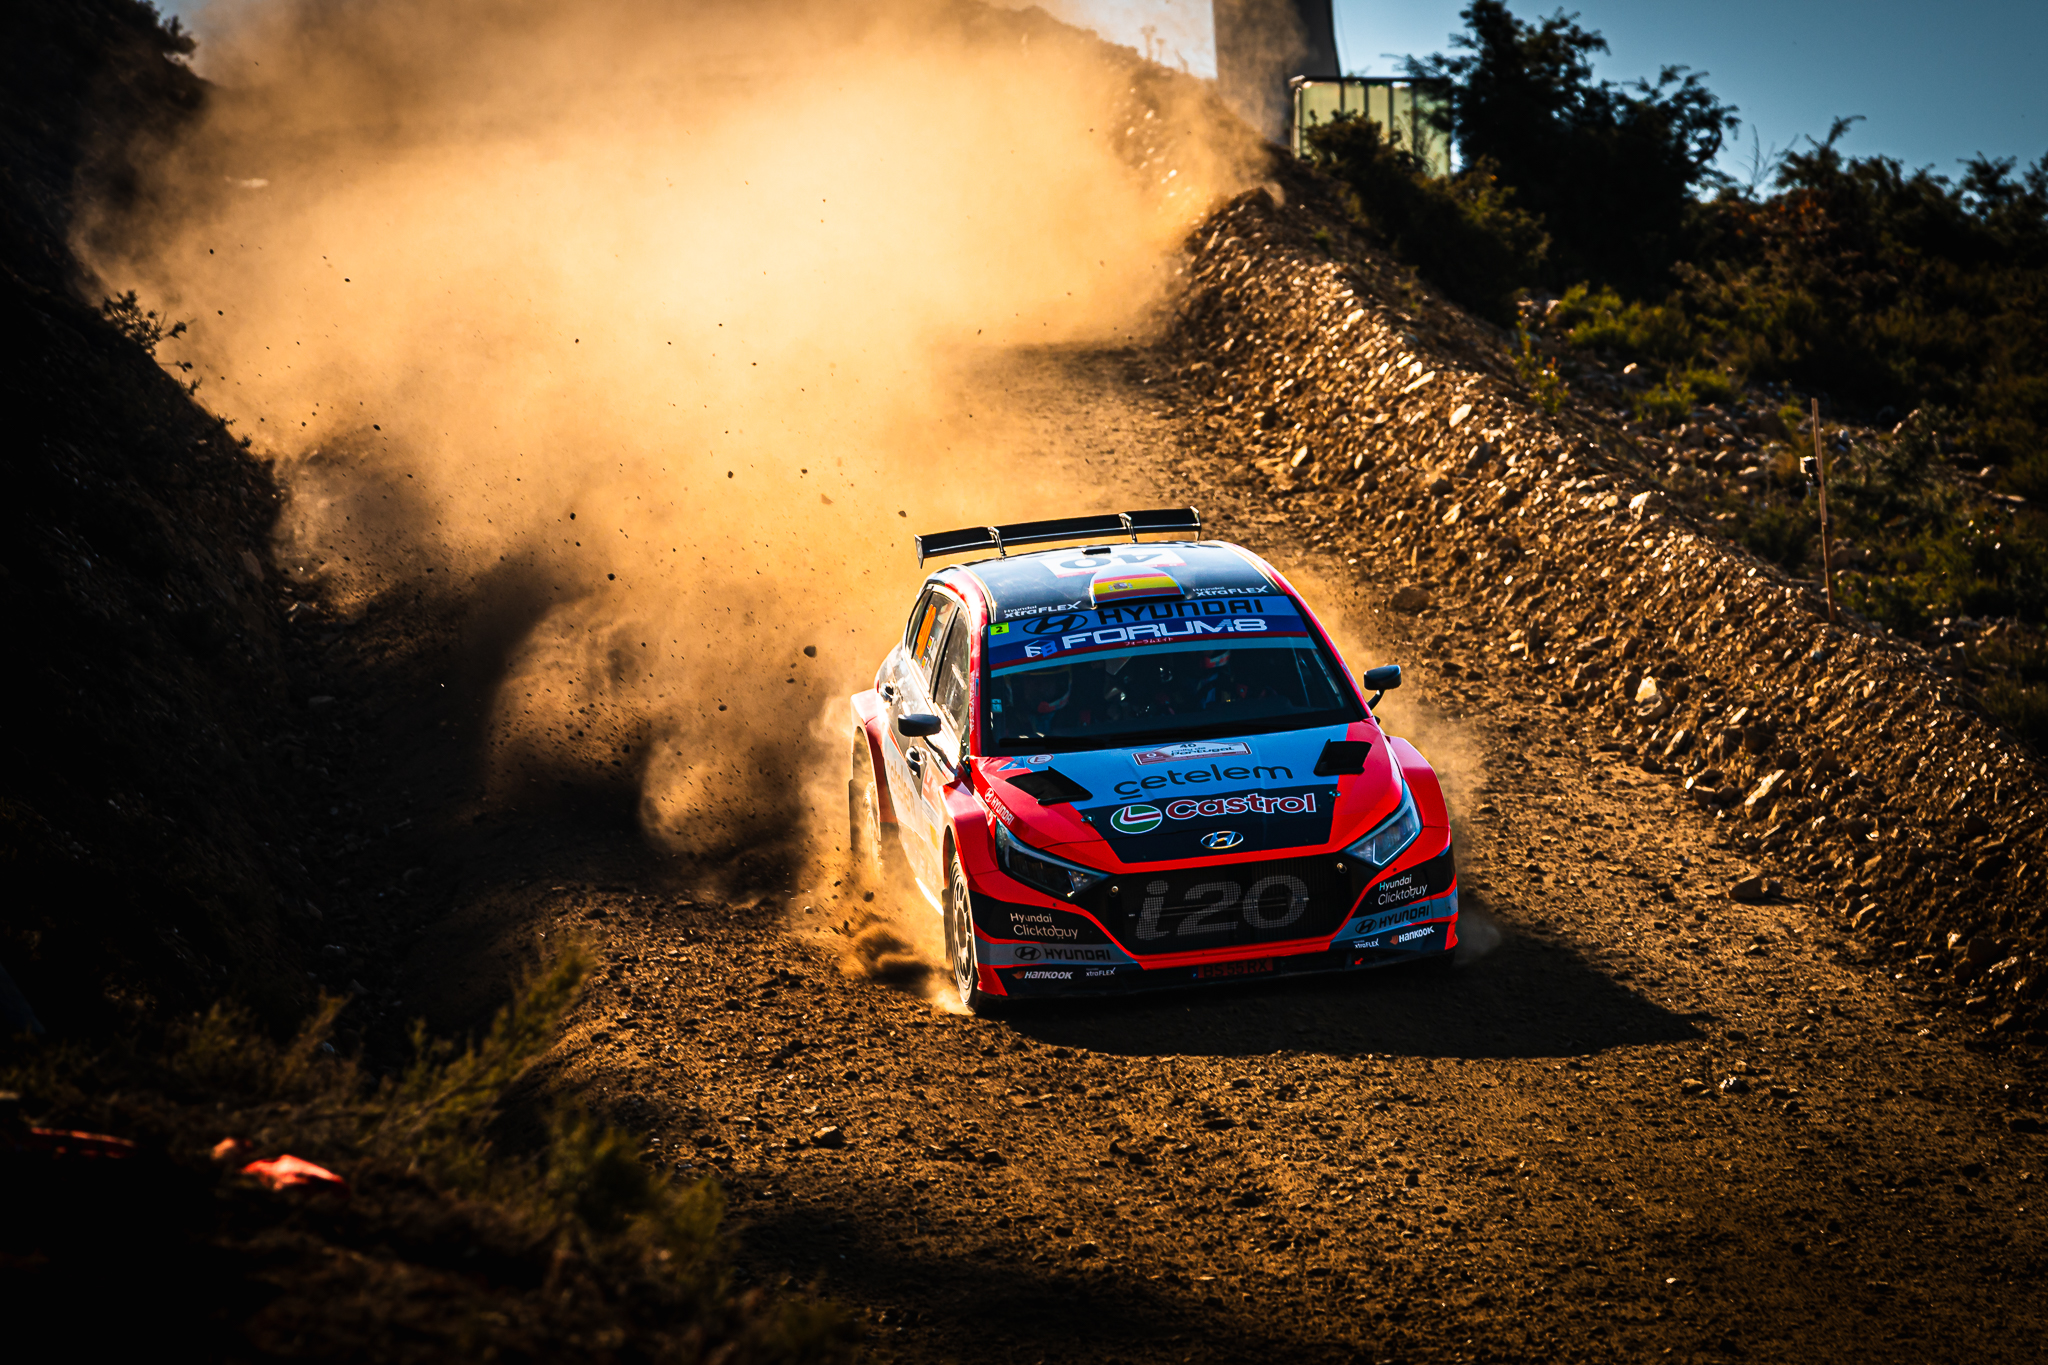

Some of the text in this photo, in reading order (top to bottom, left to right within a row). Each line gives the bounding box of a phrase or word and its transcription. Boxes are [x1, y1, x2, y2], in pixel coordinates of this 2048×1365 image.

[1004, 601, 1082, 619] xtraFLEX
[1097, 599, 1264, 625] HYUNDAI
[1061, 618, 1268, 650] FORUM8
[1113, 763, 1294, 800] cetelem
[991, 796, 1015, 826] HYUNDAI
[1165, 792, 1317, 820] Castrol
[1379, 874, 1412, 892] Hyundai
[1009, 913, 1053, 923] Hyundai
[1135, 875, 1309, 940] i20
[1379, 905, 1430, 929] HYUNDAI
[1044, 948, 1111, 961] HYUNDAI
[1203, 959, 1268, 978] BS 55 RX
